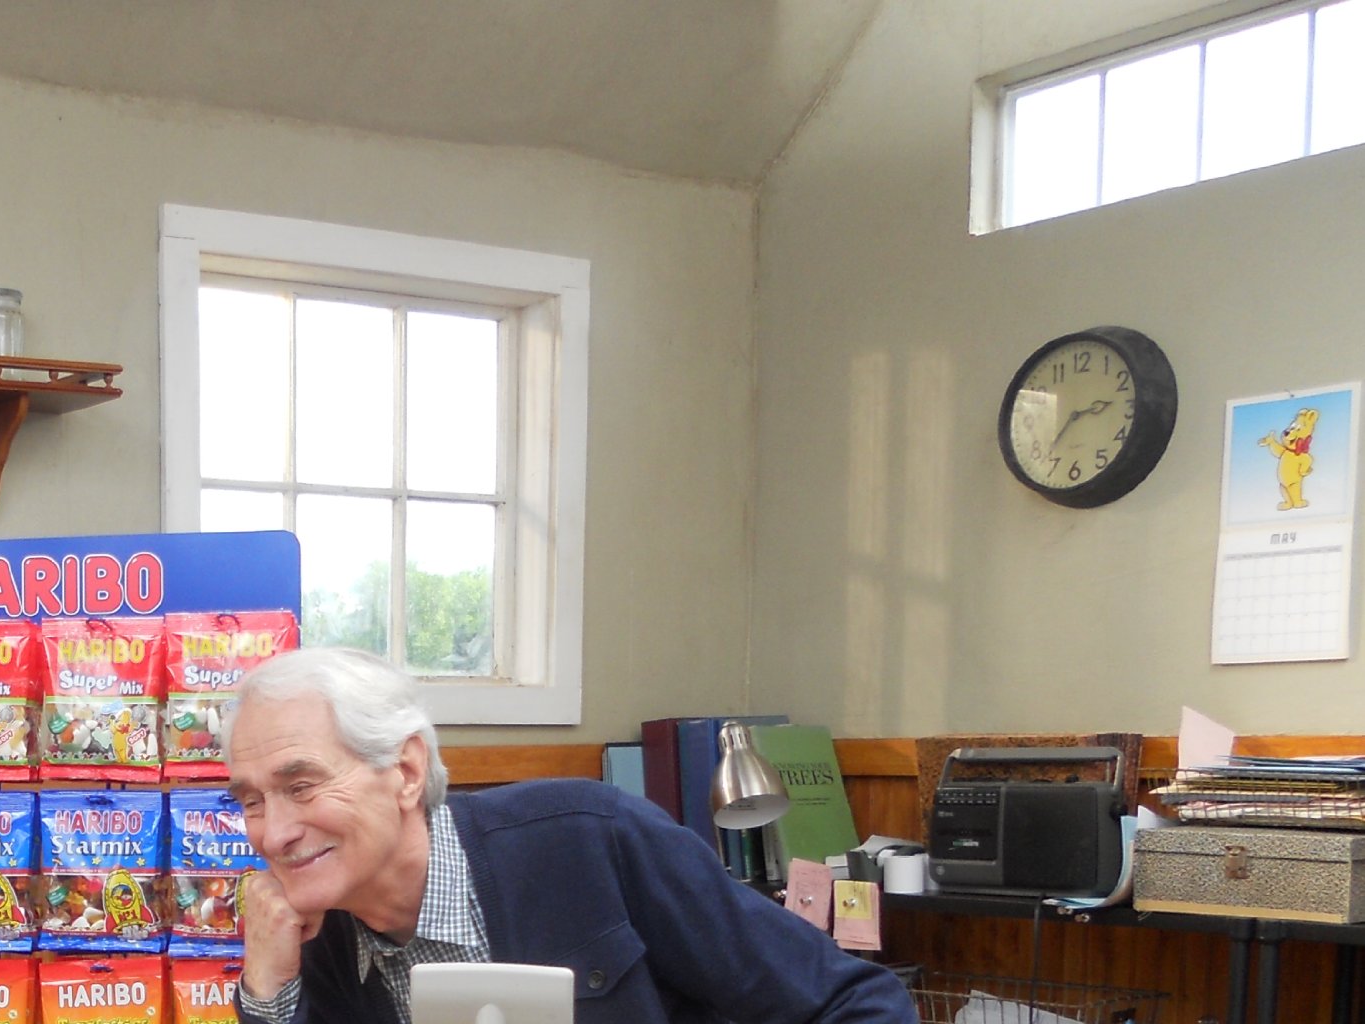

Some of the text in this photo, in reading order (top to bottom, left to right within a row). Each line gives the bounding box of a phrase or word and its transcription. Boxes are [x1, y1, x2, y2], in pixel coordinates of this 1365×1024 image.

[1052, 363, 1065, 385] 11
[1074, 352, 1091, 374] 12
[1116, 370, 1130, 392] 2
[1124, 399, 1135, 420] 3
[1114, 426, 1129, 441] 4
[1031, 441, 1042, 460] 8
[1095, 449, 1109, 469] 5
[1047, 457, 1062, 477] 7
[1068, 460, 1082, 481] 6
[58, 637, 146, 663] HARIBO
[182, 632, 274, 658] HARIBO
[59, 669, 144, 695] Super Mix
[184, 665, 243, 689] Super
[55, 810, 143, 835] HARIBO
[51, 835, 143, 855] Starmix
[181, 836, 260, 856] Starm
[58, 982, 146, 1008] HARIBO
